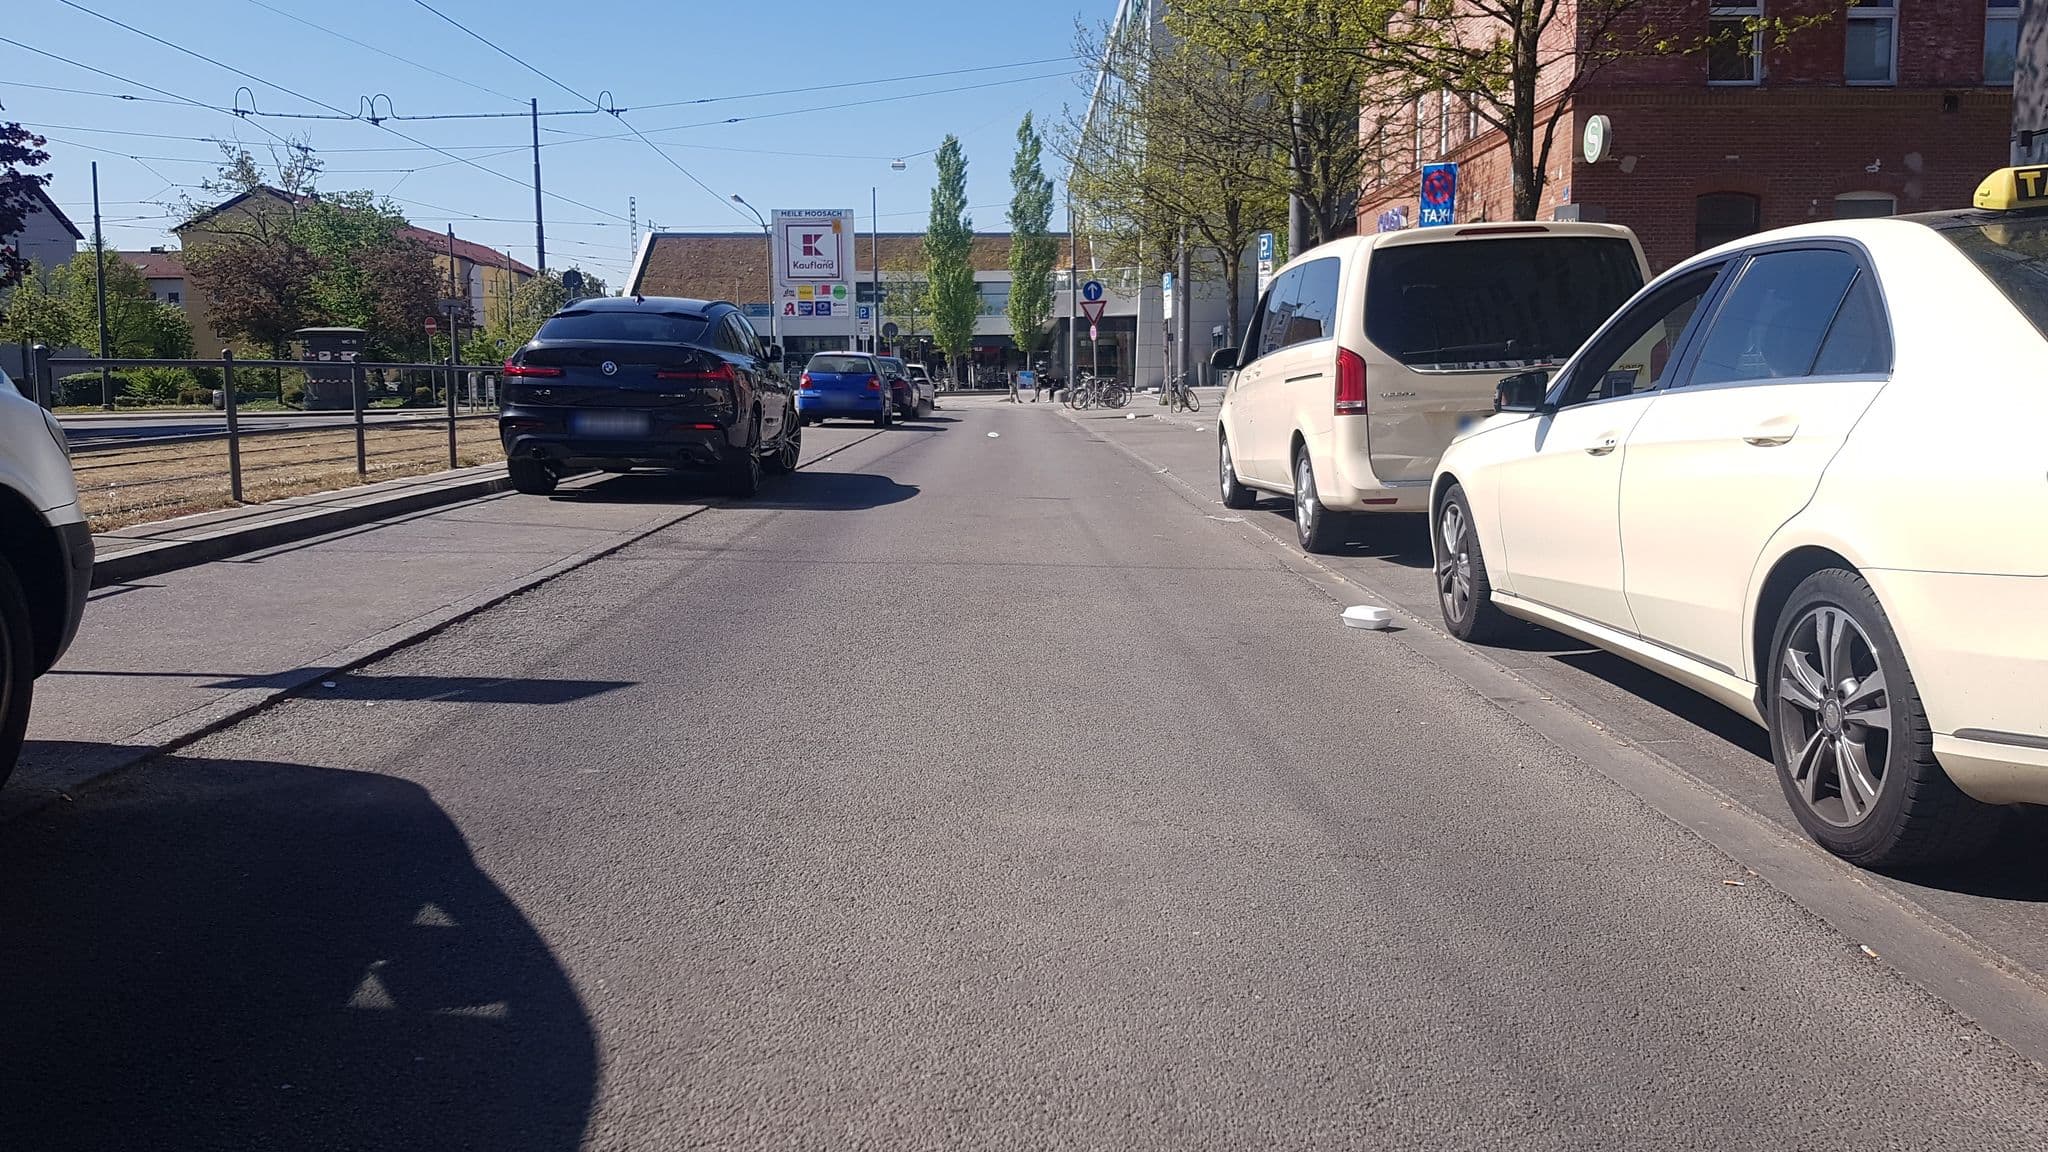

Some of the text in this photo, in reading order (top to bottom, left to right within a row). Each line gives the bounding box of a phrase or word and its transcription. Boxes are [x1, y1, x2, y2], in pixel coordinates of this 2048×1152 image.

[2018, 170, 2048, 198] T
[1422, 208, 1451, 223] TAXI
[792, 260, 834, 270] Kaufland
